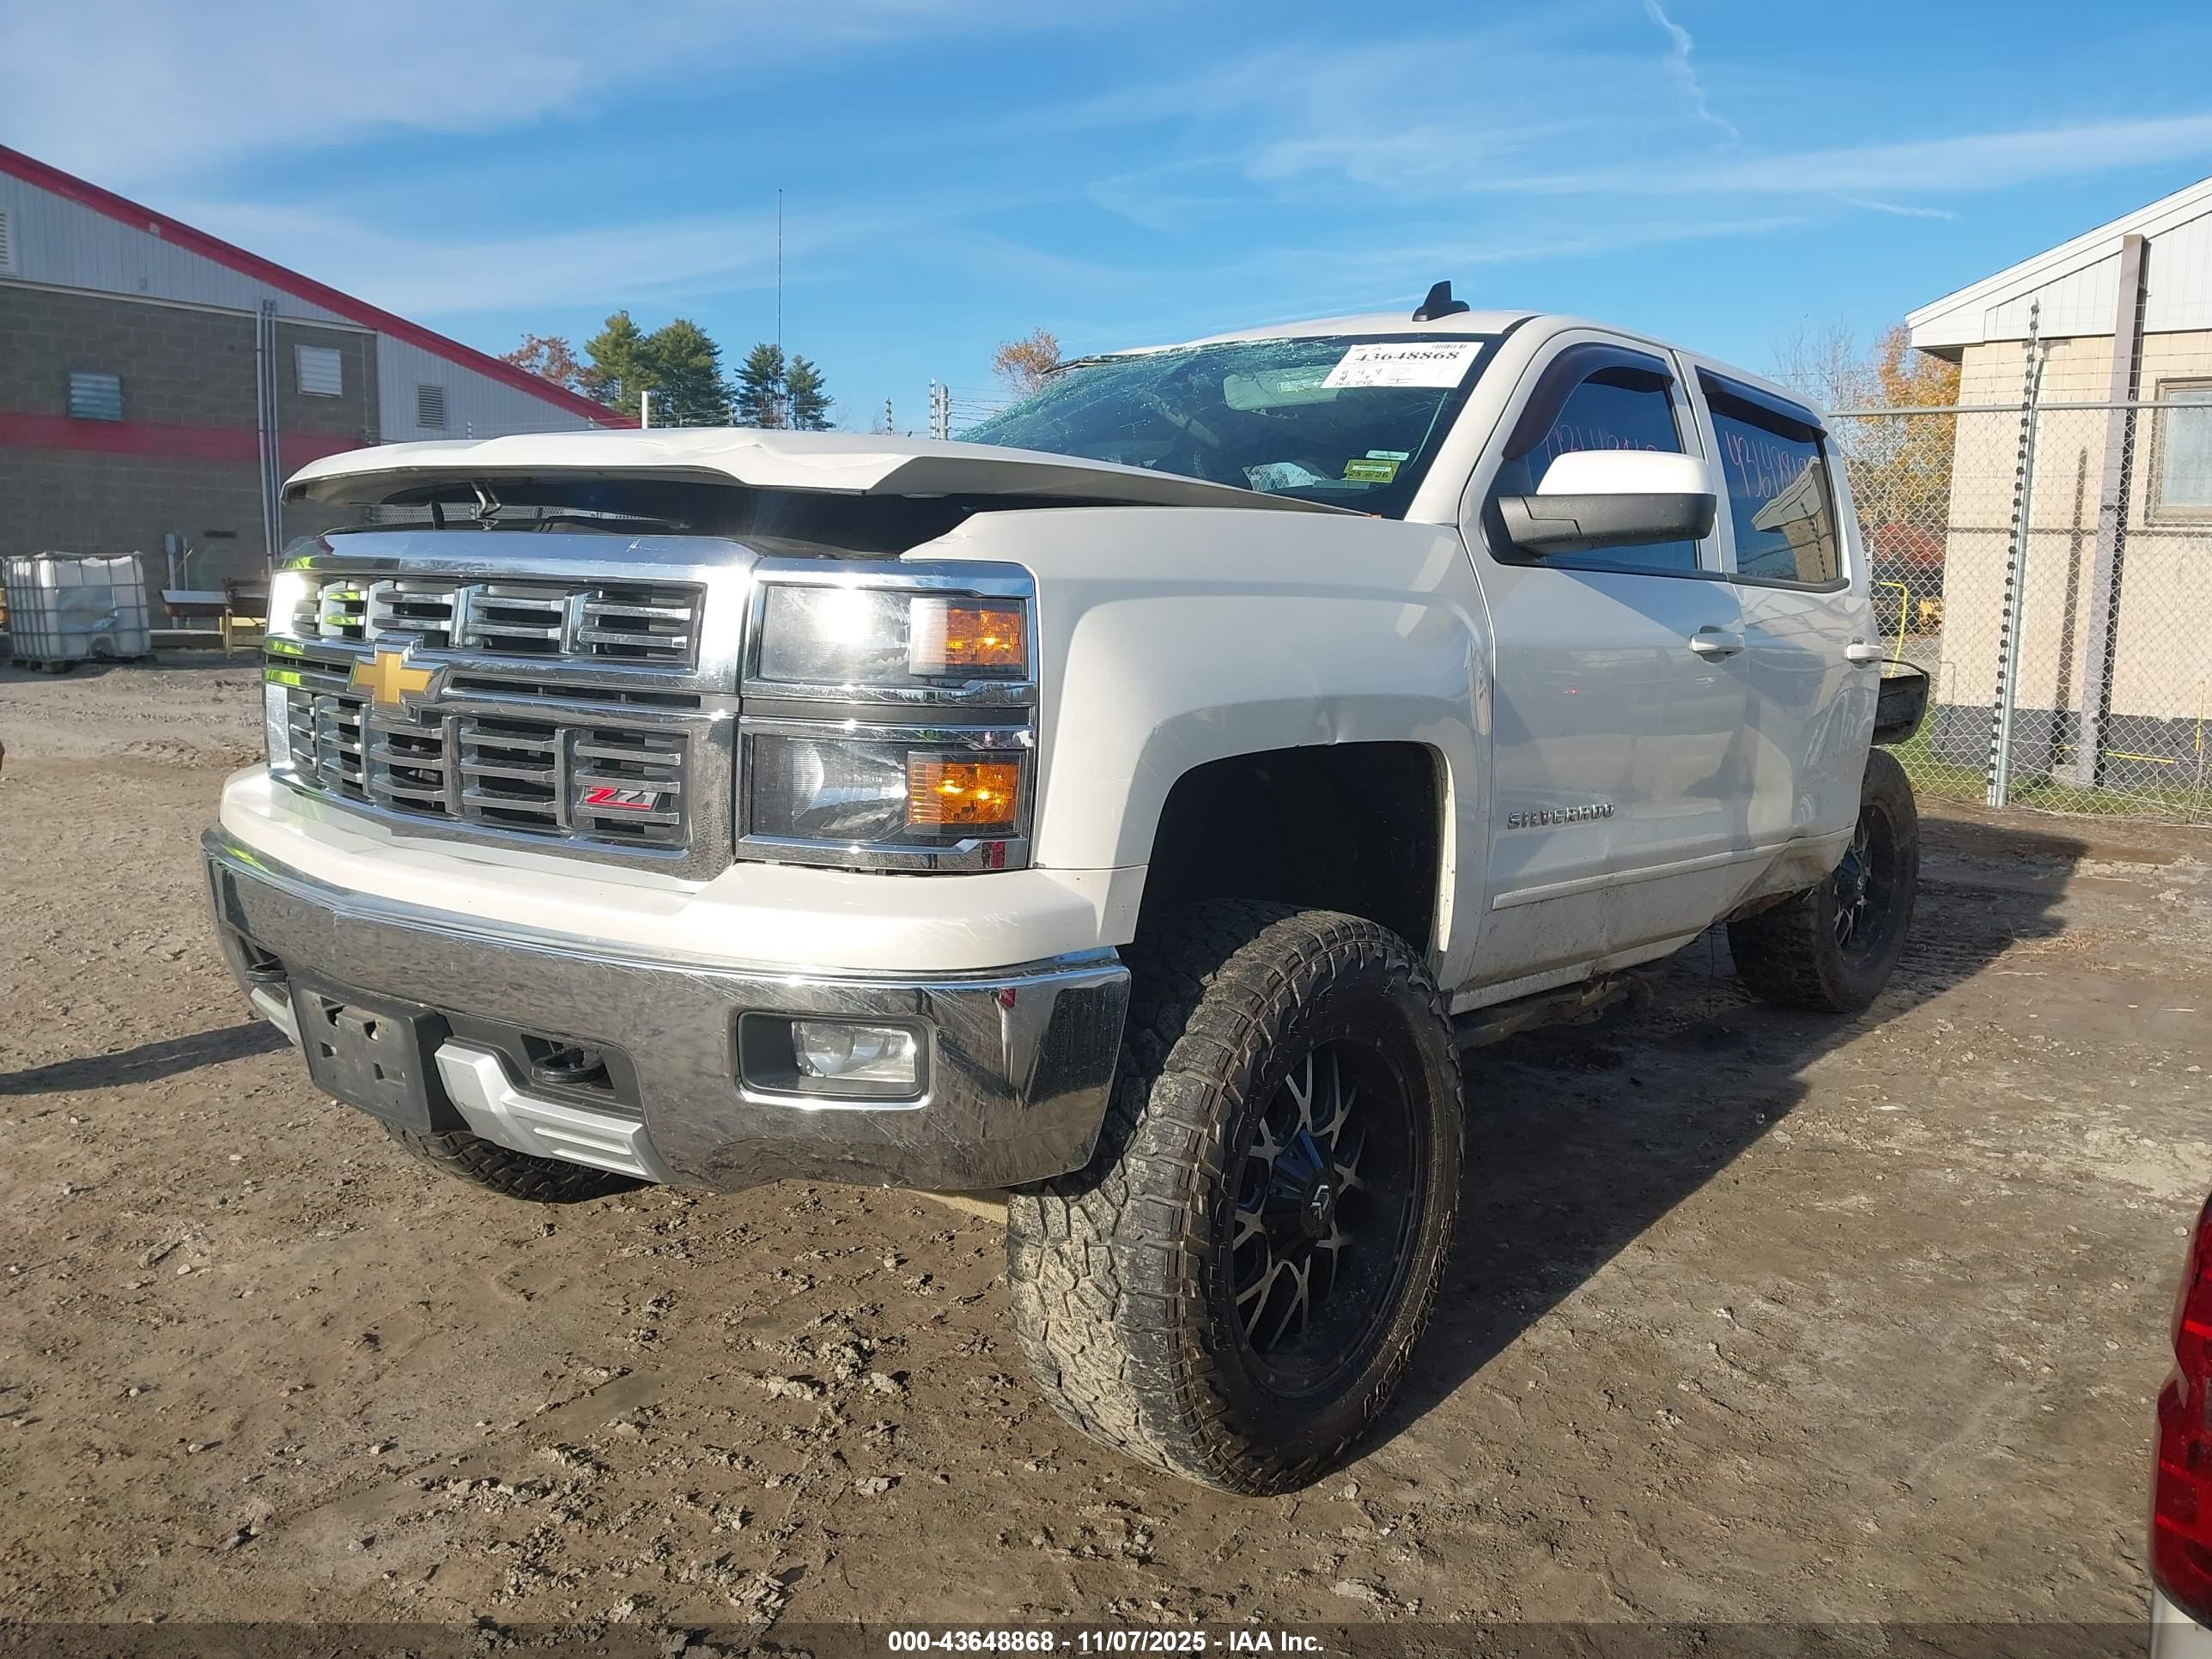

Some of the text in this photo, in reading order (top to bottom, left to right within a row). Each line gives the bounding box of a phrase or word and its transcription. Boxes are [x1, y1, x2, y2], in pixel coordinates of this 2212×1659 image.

[1355, 351, 1460, 362] 43648868
[584, 786, 658, 811] Z71
[1507, 803, 1614, 830] SILVERADO
